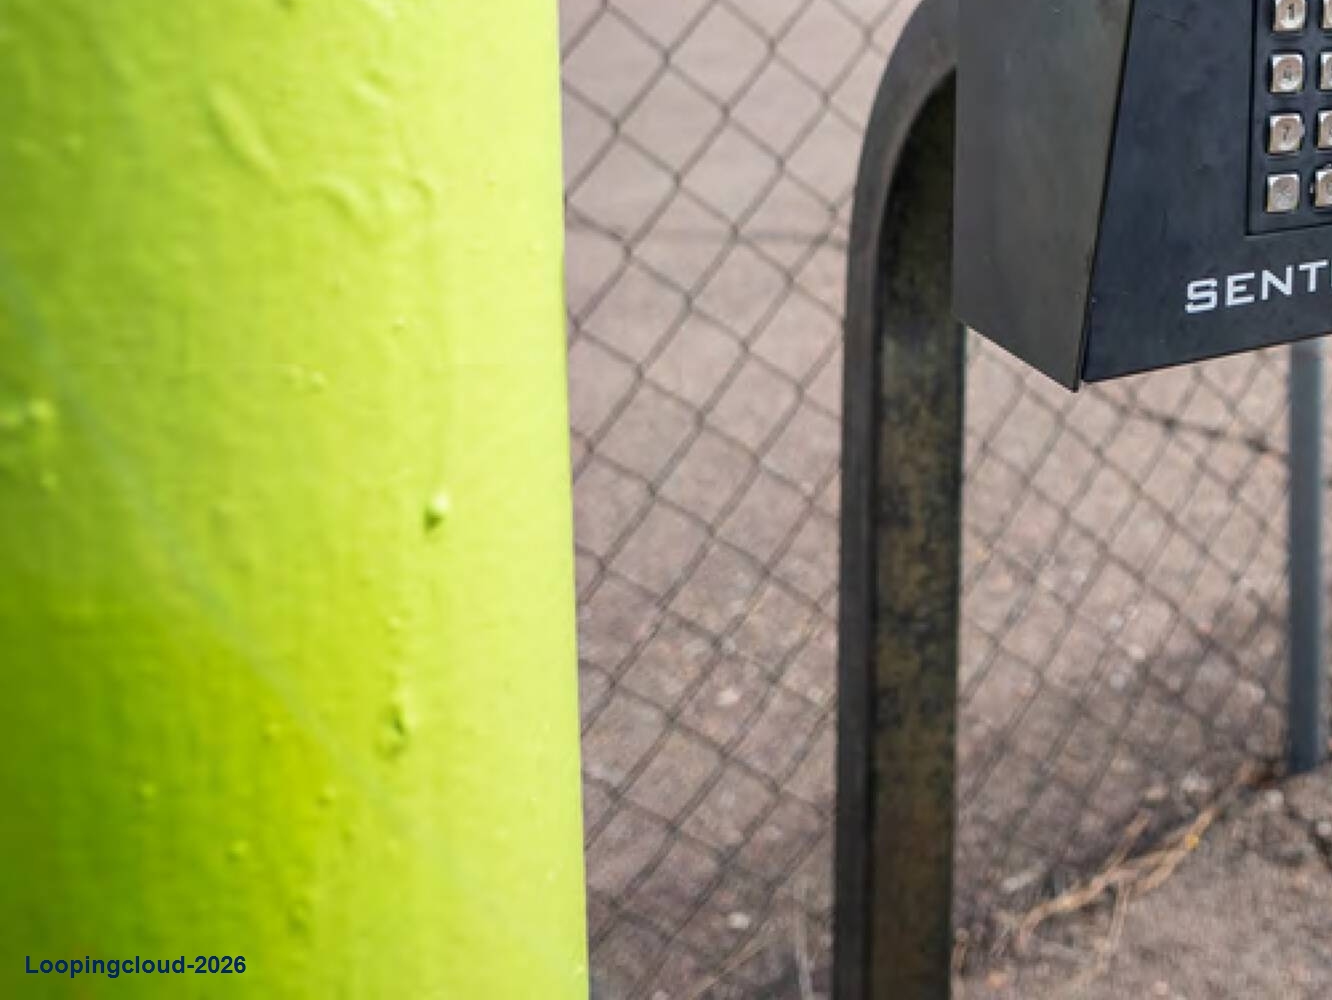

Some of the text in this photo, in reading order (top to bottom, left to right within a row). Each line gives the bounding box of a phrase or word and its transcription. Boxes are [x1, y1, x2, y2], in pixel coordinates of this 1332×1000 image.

[1287, 2, 1296, 21] 1
[1282, 63, 1293, 81] 4
[1281, 124, 1292, 141] 7
